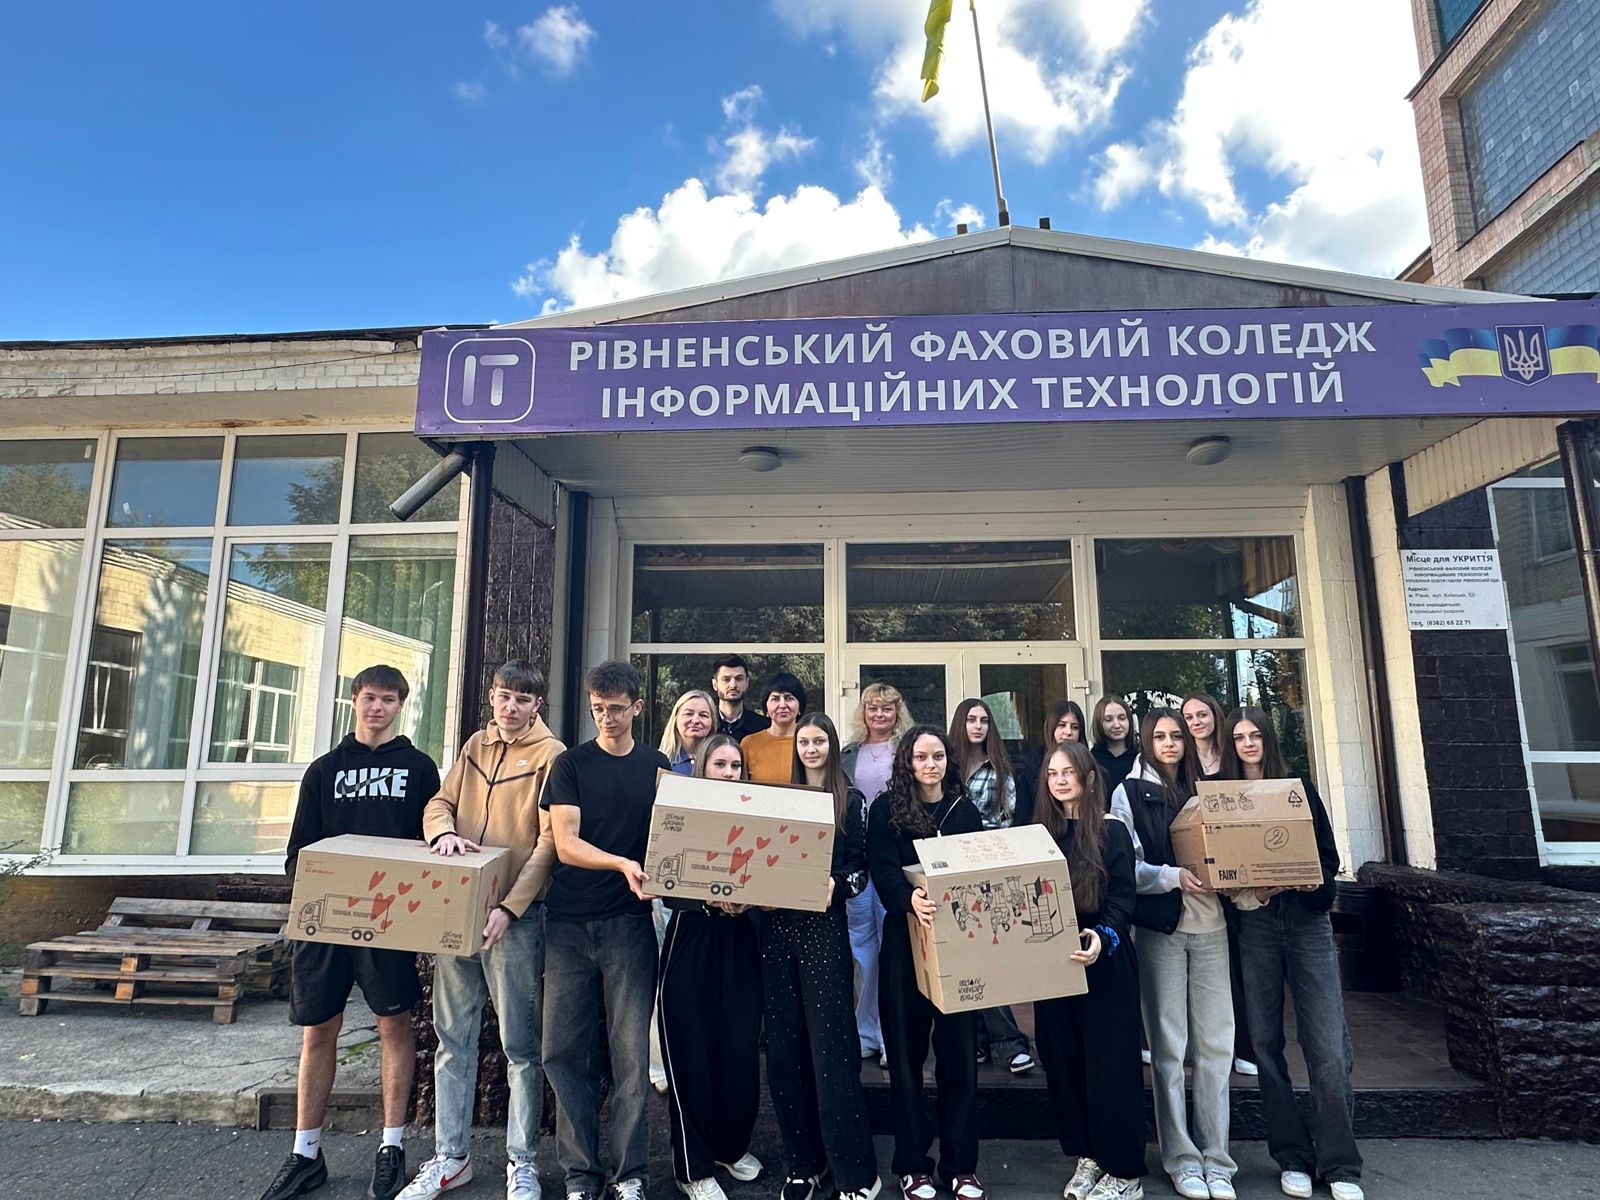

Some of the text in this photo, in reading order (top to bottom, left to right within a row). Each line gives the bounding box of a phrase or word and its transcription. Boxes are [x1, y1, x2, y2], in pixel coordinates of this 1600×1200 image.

[570, 317, 1377, 371] РІВНЕНСЬКИЙ ФАХОВИЙ КОЛЕДЖ
[601, 361, 1344, 421] ІНФОРМАЦІЙНИХ ТЕХНОЛОГІЙ
[1406, 555, 1431, 563] Місце
[334, 767, 409, 799] NIKE
[1218, 869, 1237, 880] FAIRY
